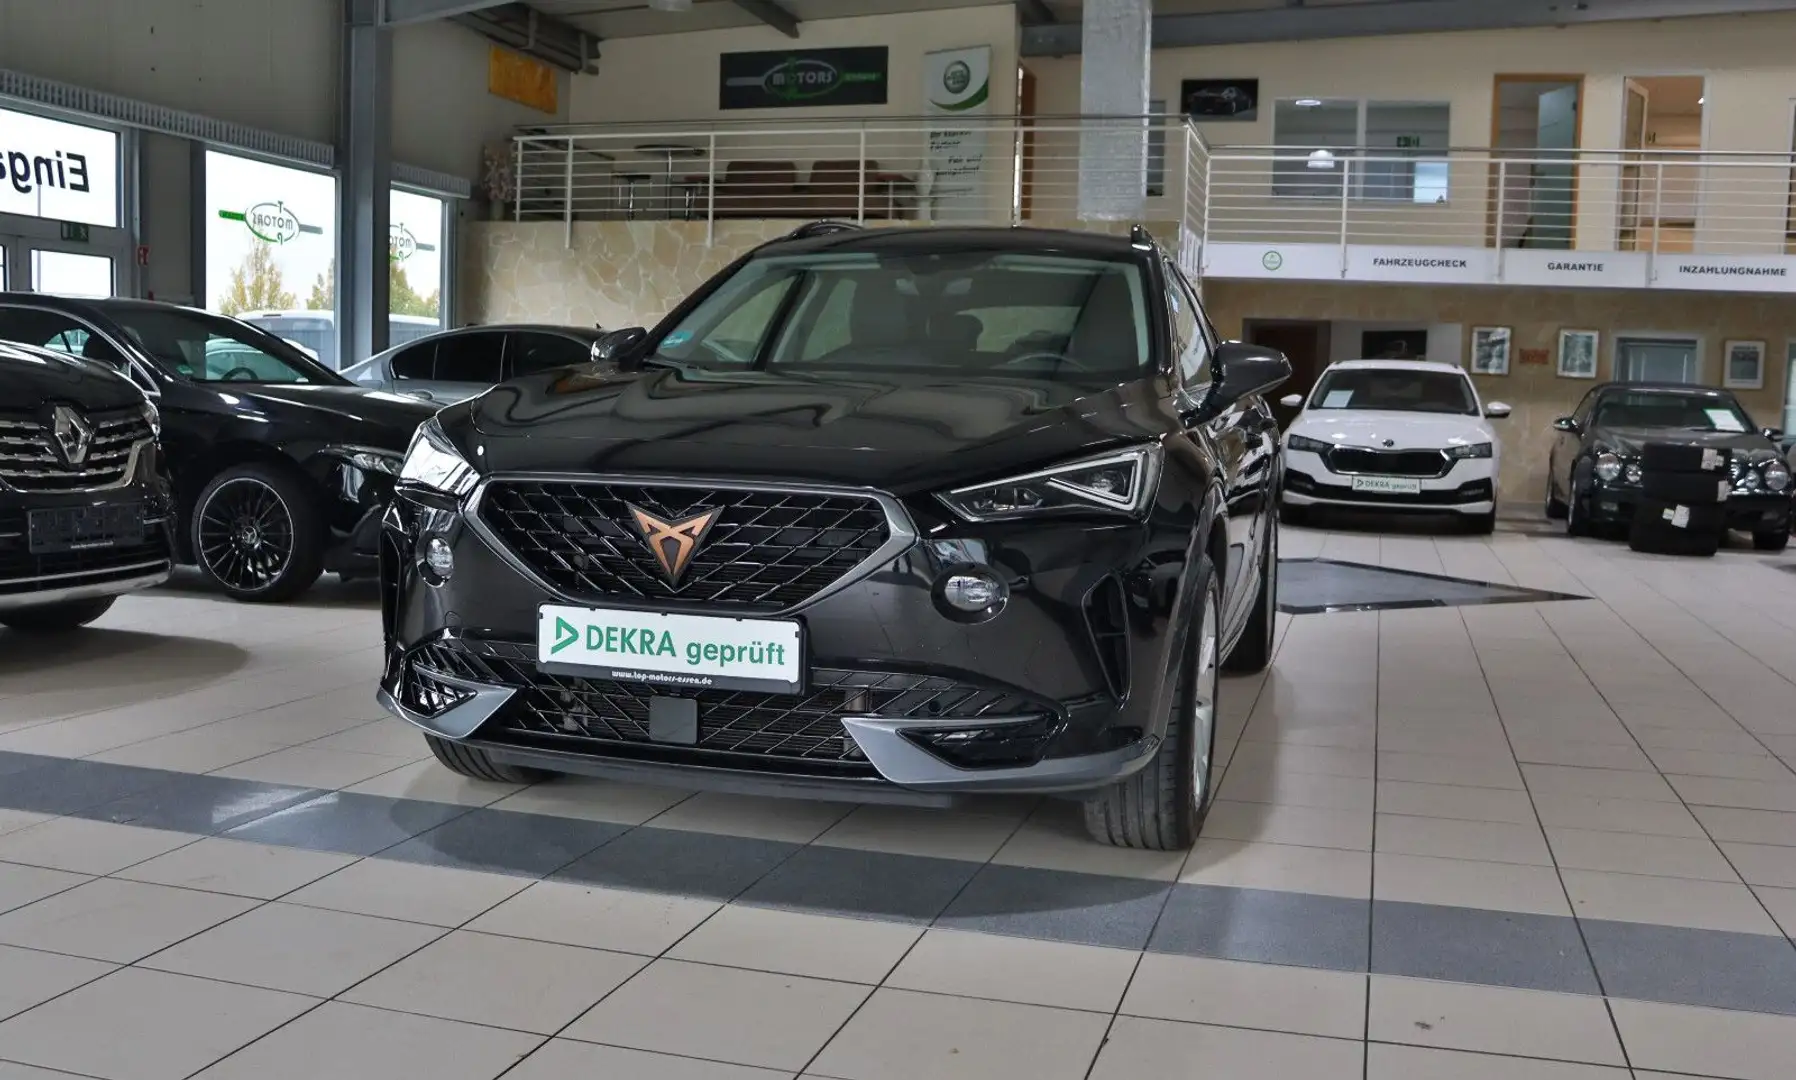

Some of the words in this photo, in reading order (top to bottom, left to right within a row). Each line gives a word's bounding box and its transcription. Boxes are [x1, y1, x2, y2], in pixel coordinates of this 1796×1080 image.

[1372, 257, 1467, 268] FAHRZEUGCHECK
[1547, 262, 1604, 272] GARANTIE
[1679, 265, 1787, 276] INZAHLUNGNAHME
[585, 625, 677, 657] DEKRA
[686, 641, 785, 667] geprüft
[611, 670, 713, 685] www.top-motors-essen.de
